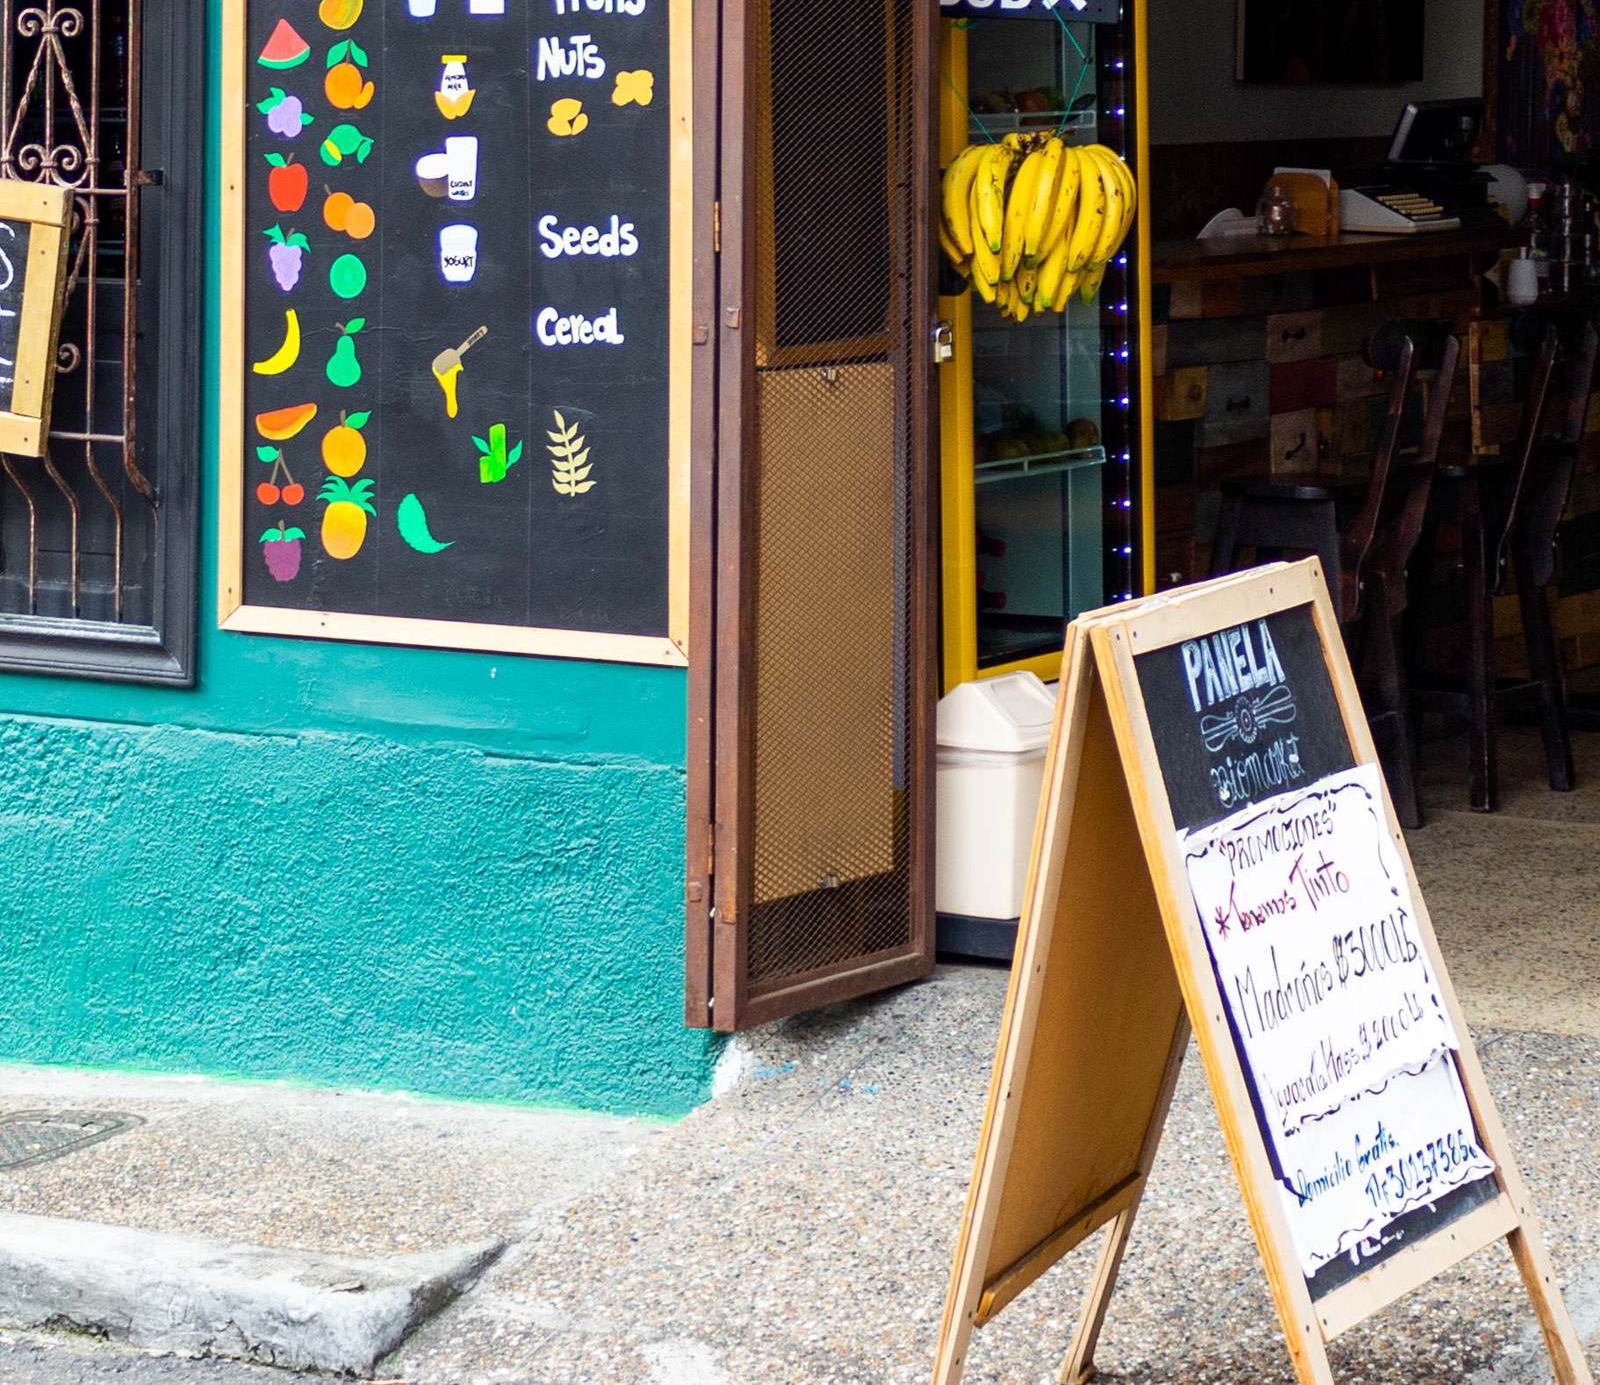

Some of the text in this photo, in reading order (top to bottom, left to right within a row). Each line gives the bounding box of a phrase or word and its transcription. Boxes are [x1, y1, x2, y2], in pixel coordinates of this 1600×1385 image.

[444, 255, 474, 268] YOGURT
[538, 214, 639, 259] Seeds
[1181, 619, 1286, 713] PANELA
[1289, 850, 1350, 911] Tinto
